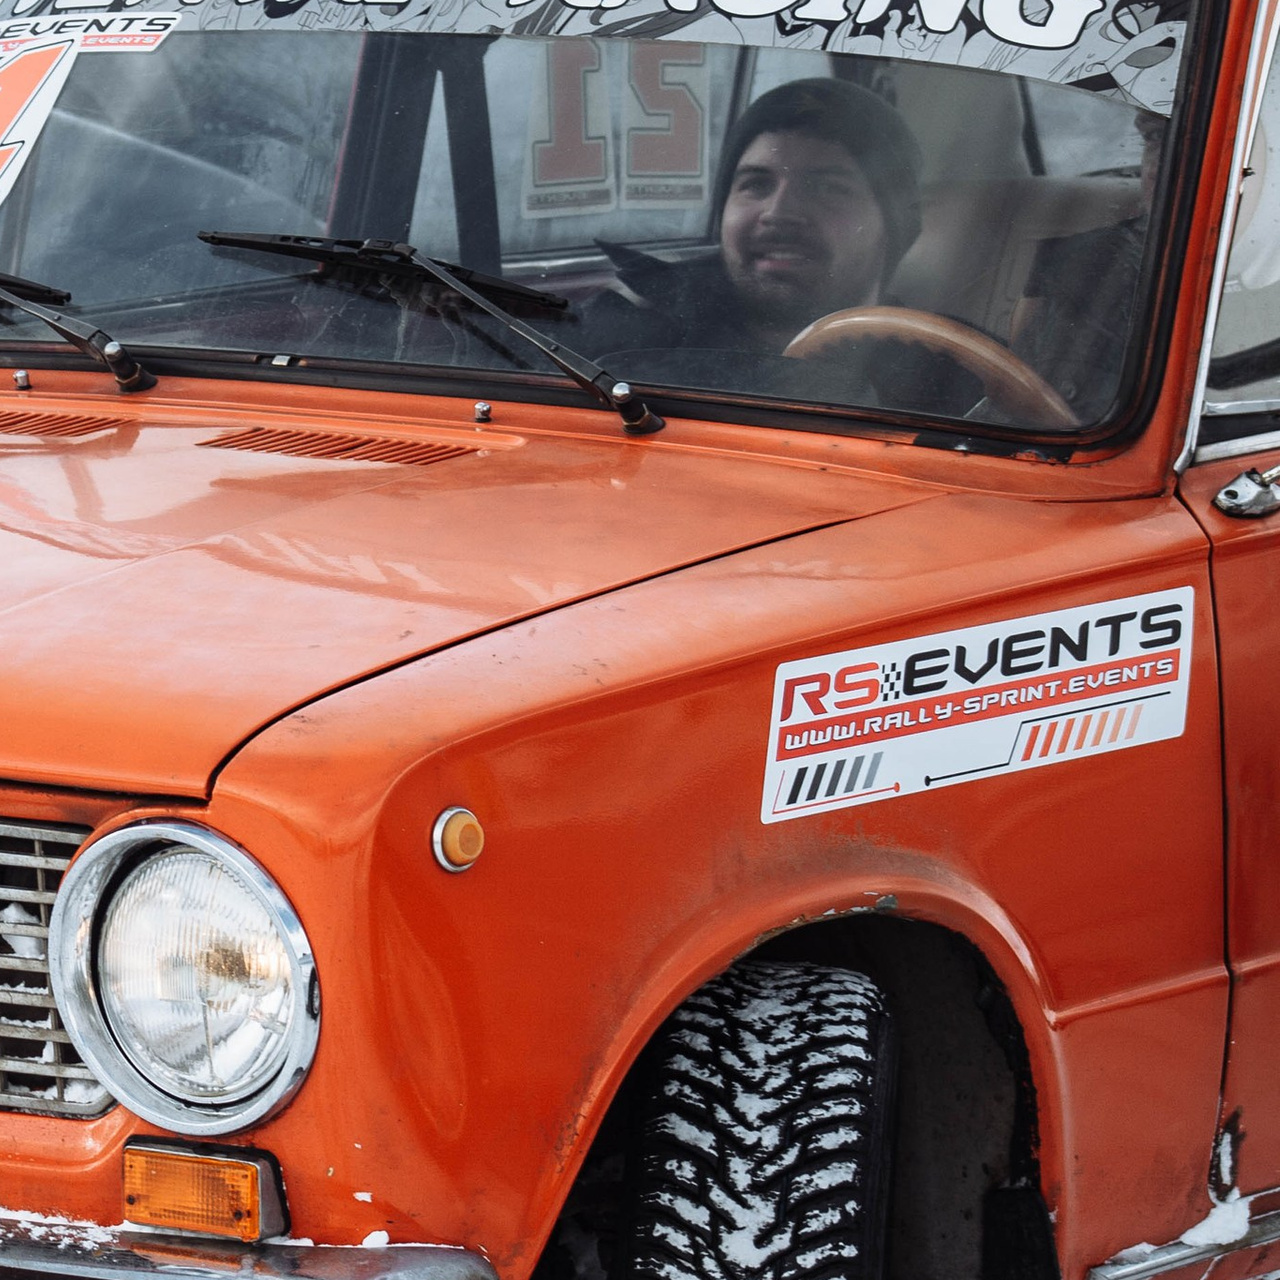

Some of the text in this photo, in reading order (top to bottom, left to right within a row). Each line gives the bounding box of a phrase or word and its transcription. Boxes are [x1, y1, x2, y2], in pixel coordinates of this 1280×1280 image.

[0, 17, 177, 40] EVENTS
[780, 603, 1184, 722] RS EVENTS
[785, 658, 1174, 751] WWW.RALLY-SPRINT.EVENTS
